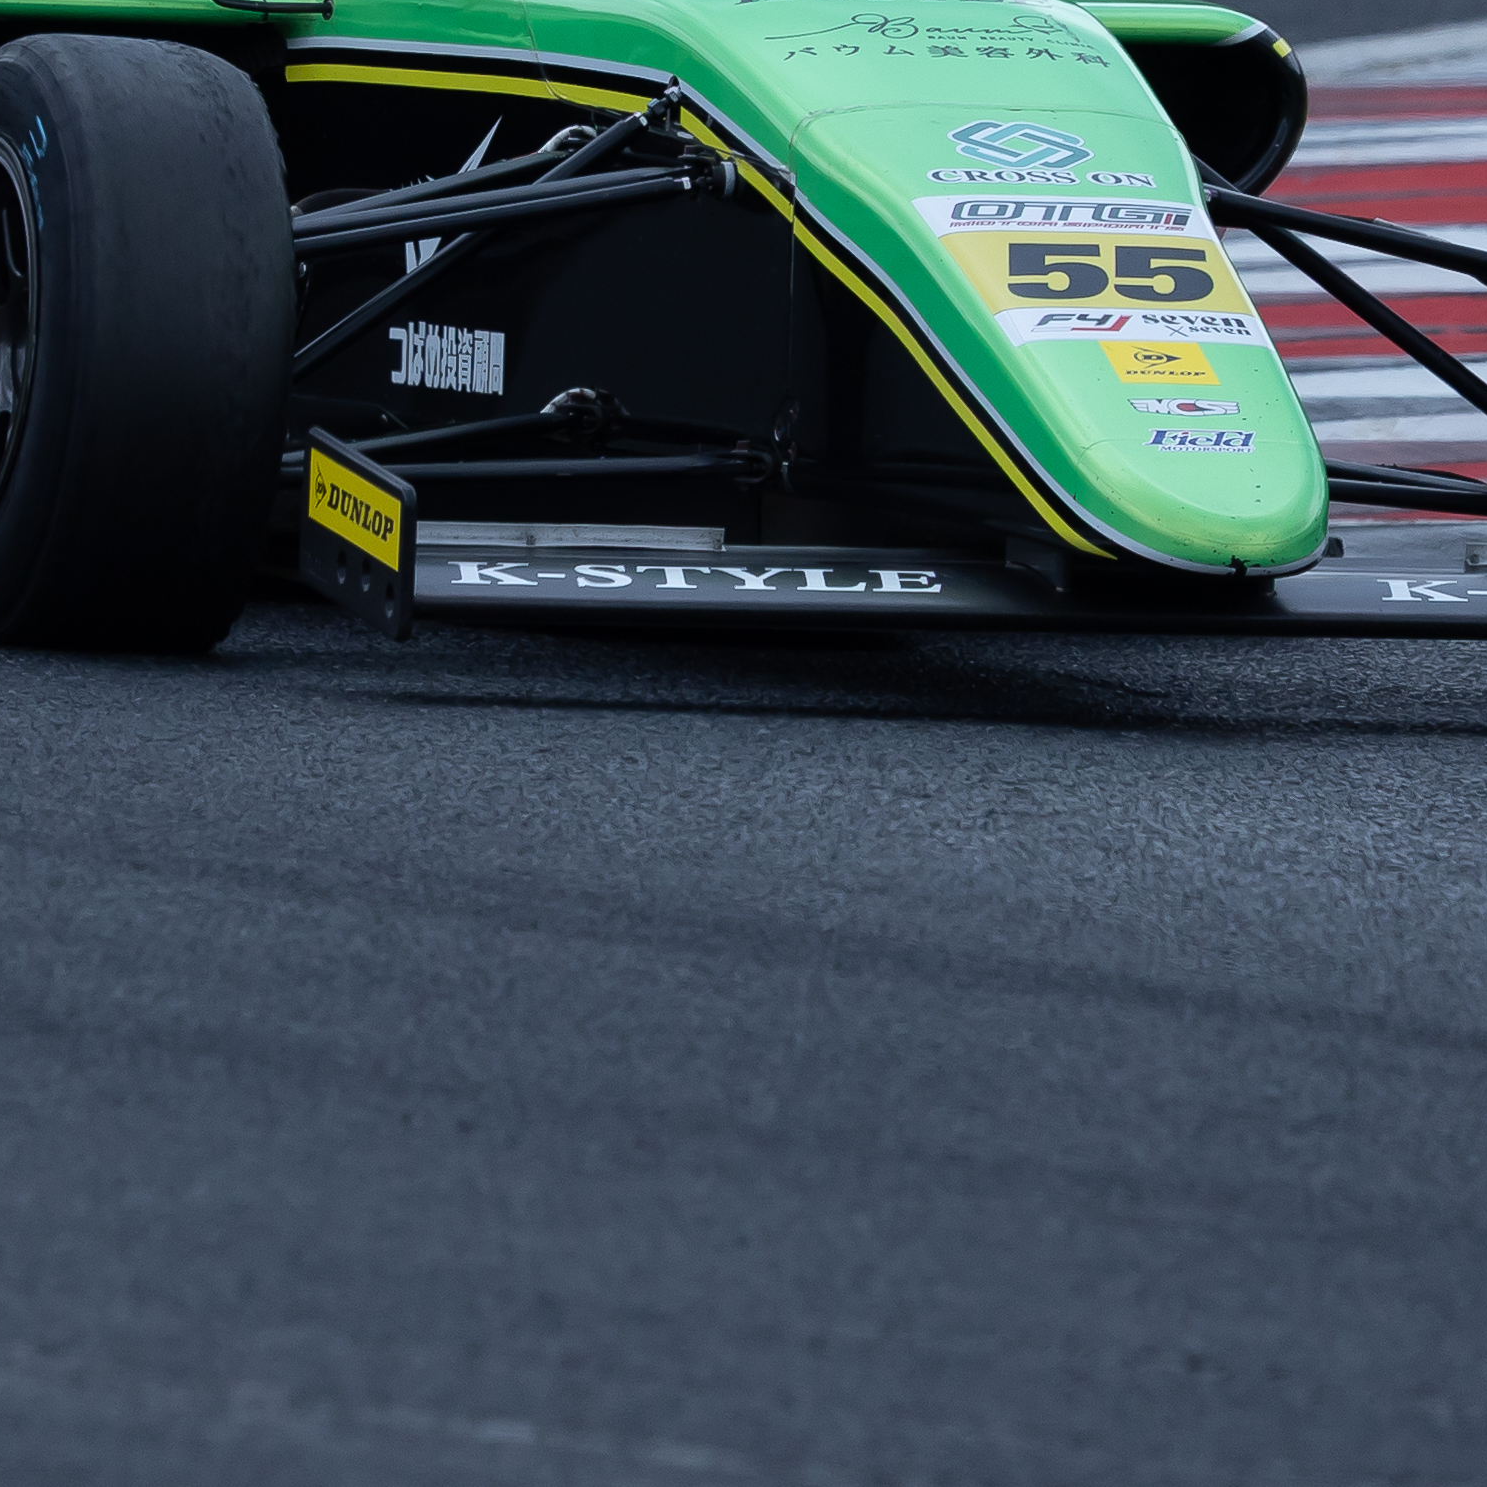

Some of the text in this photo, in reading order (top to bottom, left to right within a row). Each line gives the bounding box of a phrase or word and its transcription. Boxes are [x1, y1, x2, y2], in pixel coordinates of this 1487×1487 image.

[930, 170, 1154, 188] CROSS ON
[1007, 242, 1214, 302] 55
[1142, 314, 1248, 329] seven
[1189, 326, 1252, 336] seven
[1125, 369, 1206, 377] DUNLOP
[1149, 429, 1254, 447] Field
[1160, 445, 1253, 453] MOTORSPORT
[327, 482, 394, 543] DUNLOP
[448, 561, 942, 593] K-STYLE
